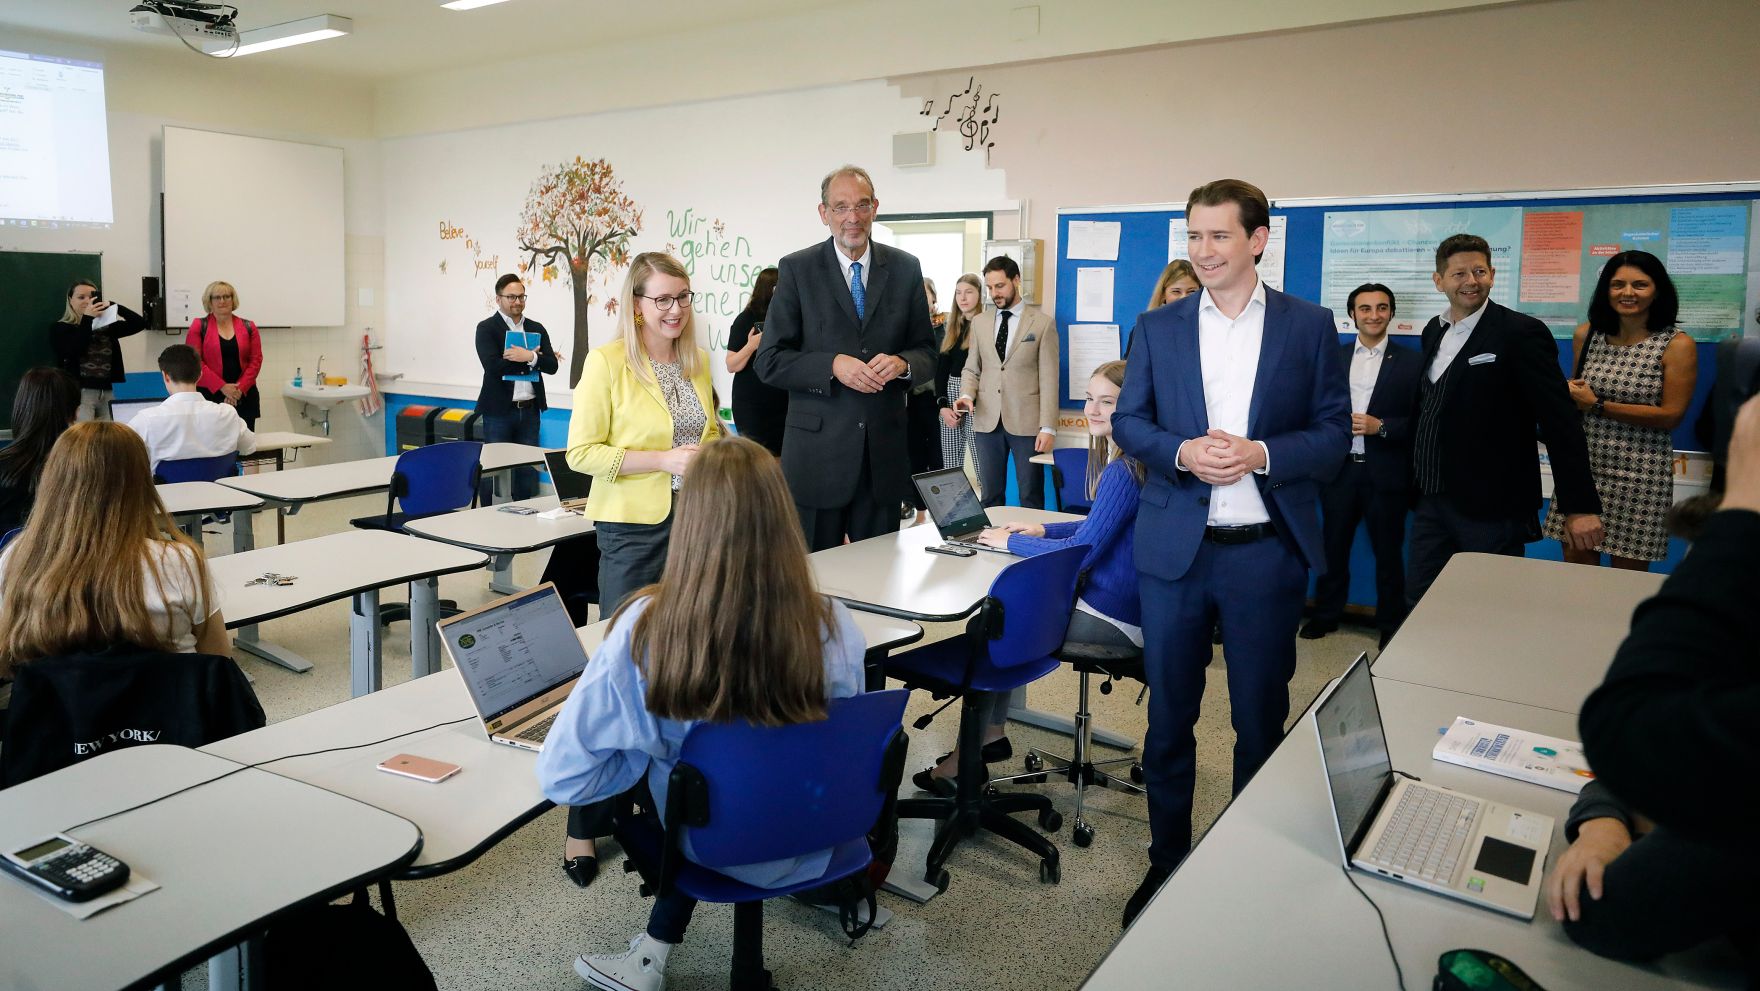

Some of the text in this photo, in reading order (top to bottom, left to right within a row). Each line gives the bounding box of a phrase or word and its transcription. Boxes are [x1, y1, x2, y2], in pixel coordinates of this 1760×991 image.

[440, 219, 464, 240] Believe
[667, 208, 706, 238] Wir
[465, 234, 473, 249] in
[681, 230, 752, 276] gehen
[474, 254, 498, 279] yourself
[711, 263, 778, 289] unse
[74, 737, 105, 755] EW
